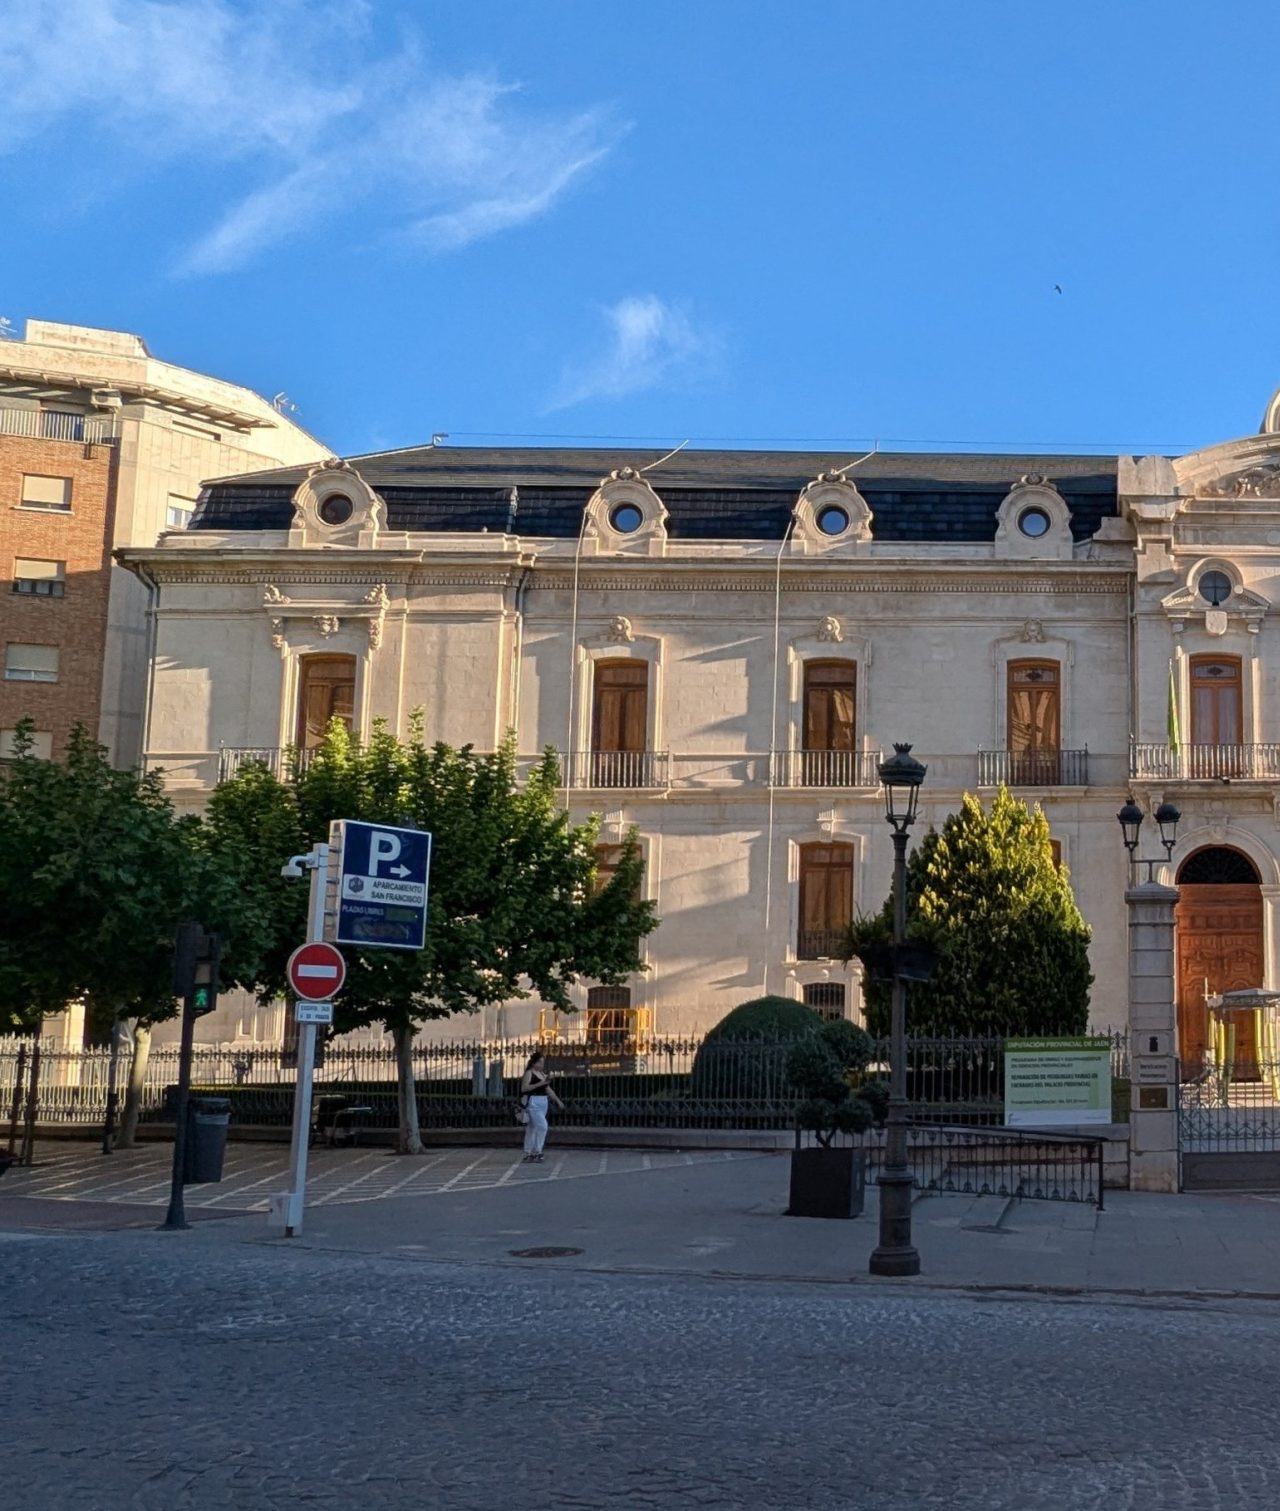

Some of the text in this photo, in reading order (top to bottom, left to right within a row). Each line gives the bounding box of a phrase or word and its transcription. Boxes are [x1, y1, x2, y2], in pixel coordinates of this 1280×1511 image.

[368, 831, 401, 877] P
[372, 880, 423, 894] APARCAMIENTO
[371, 891, 385, 900] SAN
[385, 892, 423, 904] FRANCISCO
[1007, 1040, 1045, 1048] DIPUTACIÓN
[1045, 1040, 1083, 1048] PROVINCIAL
